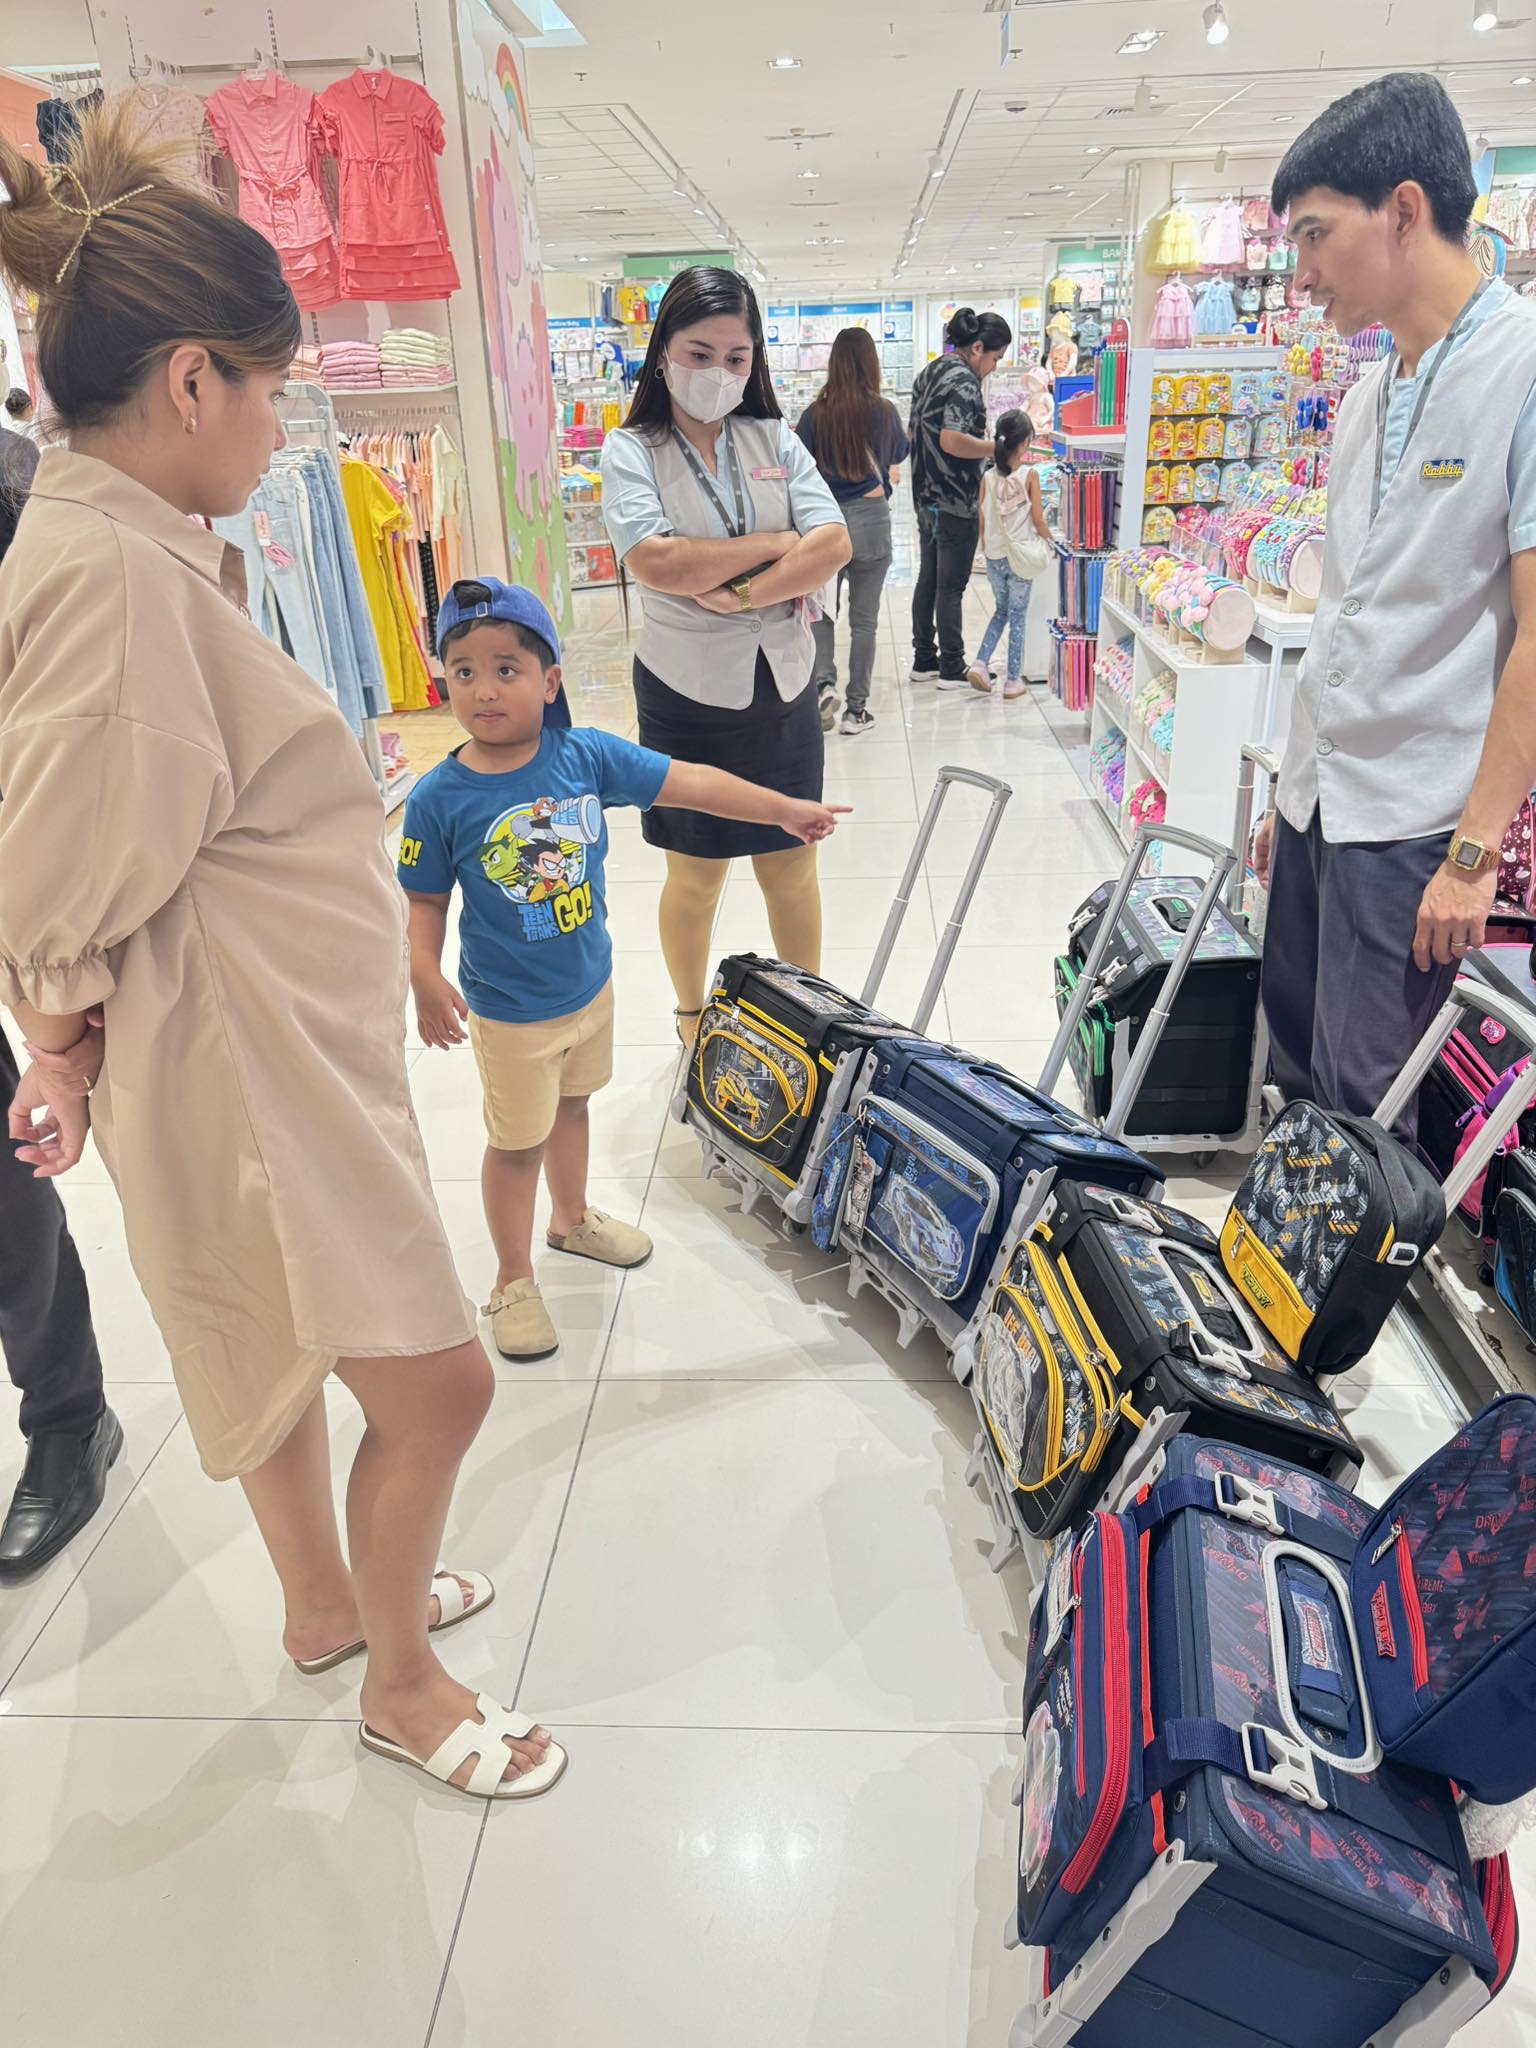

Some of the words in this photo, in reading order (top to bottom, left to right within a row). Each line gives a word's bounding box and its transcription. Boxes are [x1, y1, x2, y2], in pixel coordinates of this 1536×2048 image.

[400, 834, 422, 867] O!
[517, 900, 555, 926] TEEN
[554, 880, 593, 934] GO!
